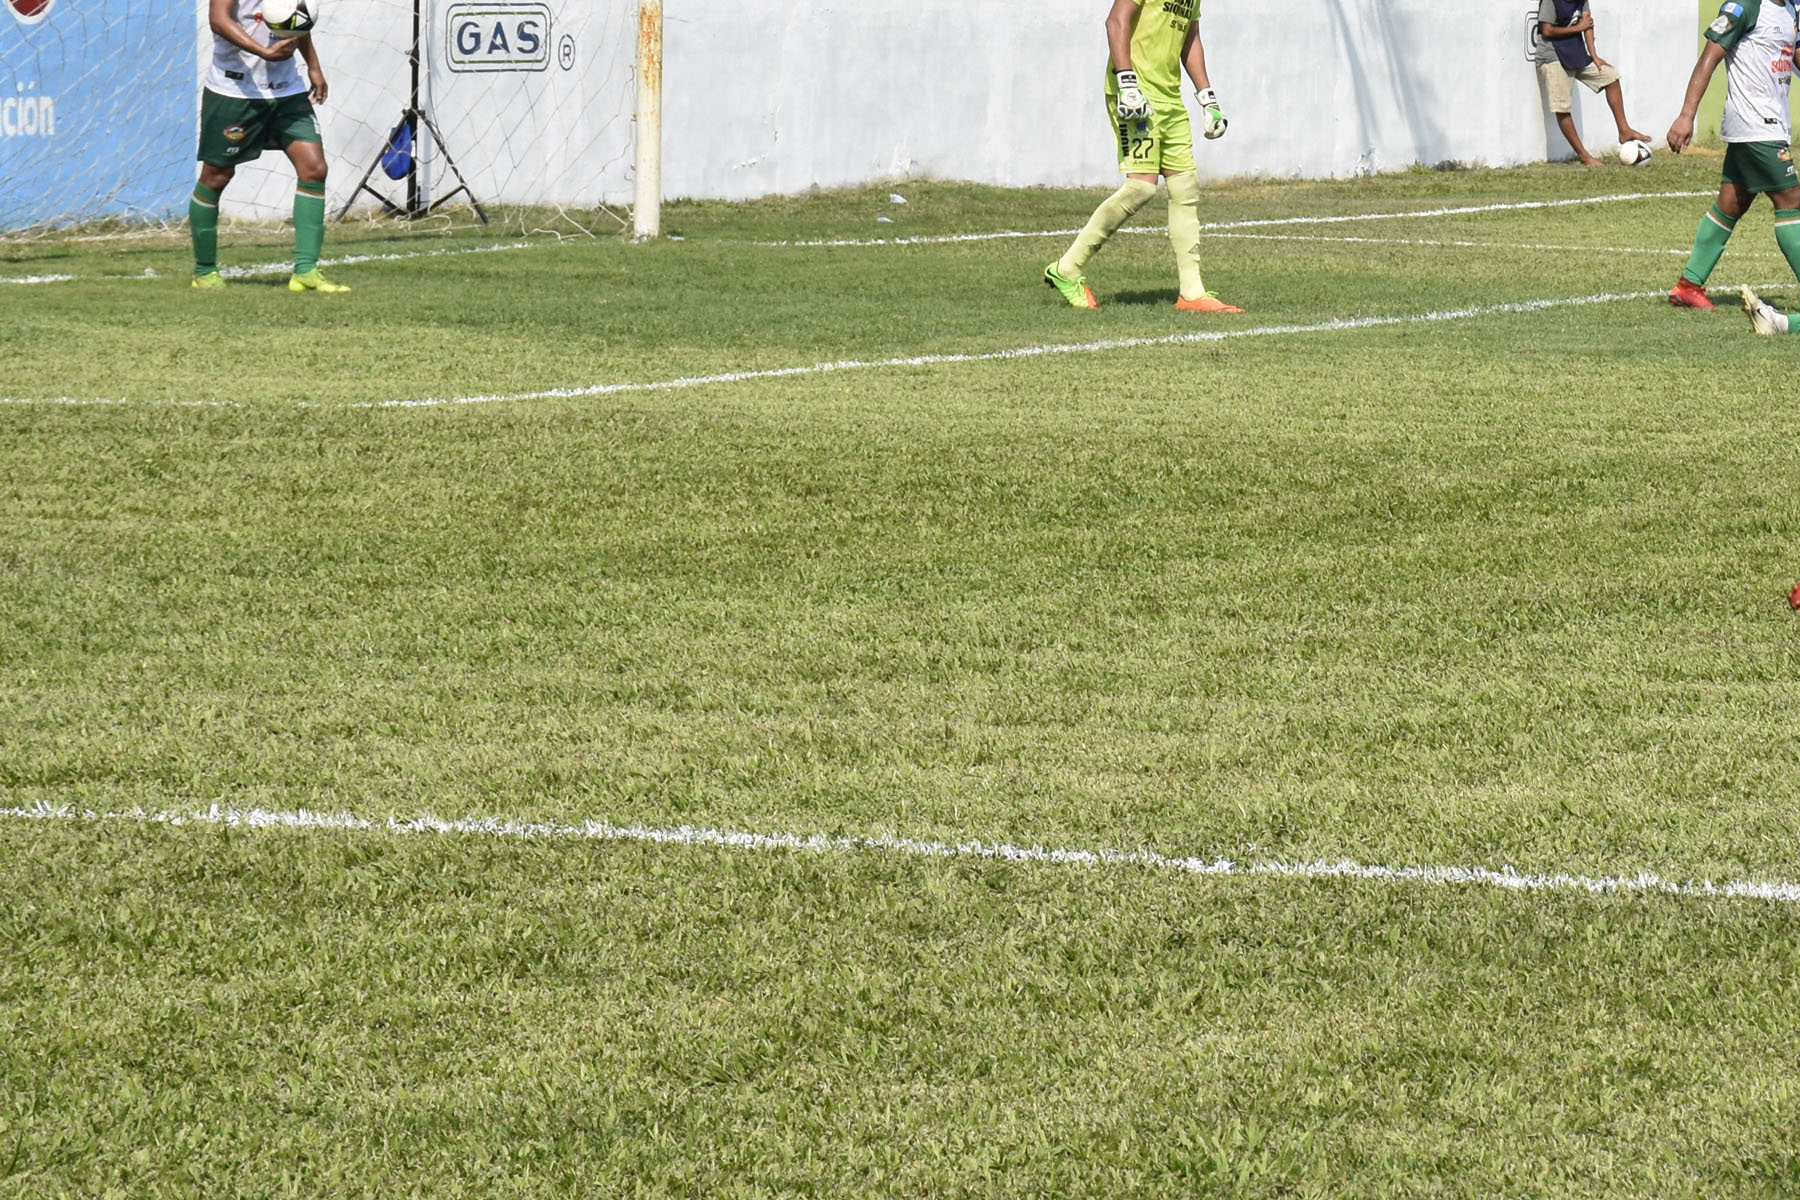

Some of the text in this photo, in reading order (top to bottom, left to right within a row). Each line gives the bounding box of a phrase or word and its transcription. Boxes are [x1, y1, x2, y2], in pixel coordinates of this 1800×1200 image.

[457, 19, 540, 56] GAS
[0, 81, 55, 136] ción
[1132, 138, 1154, 159] 27
